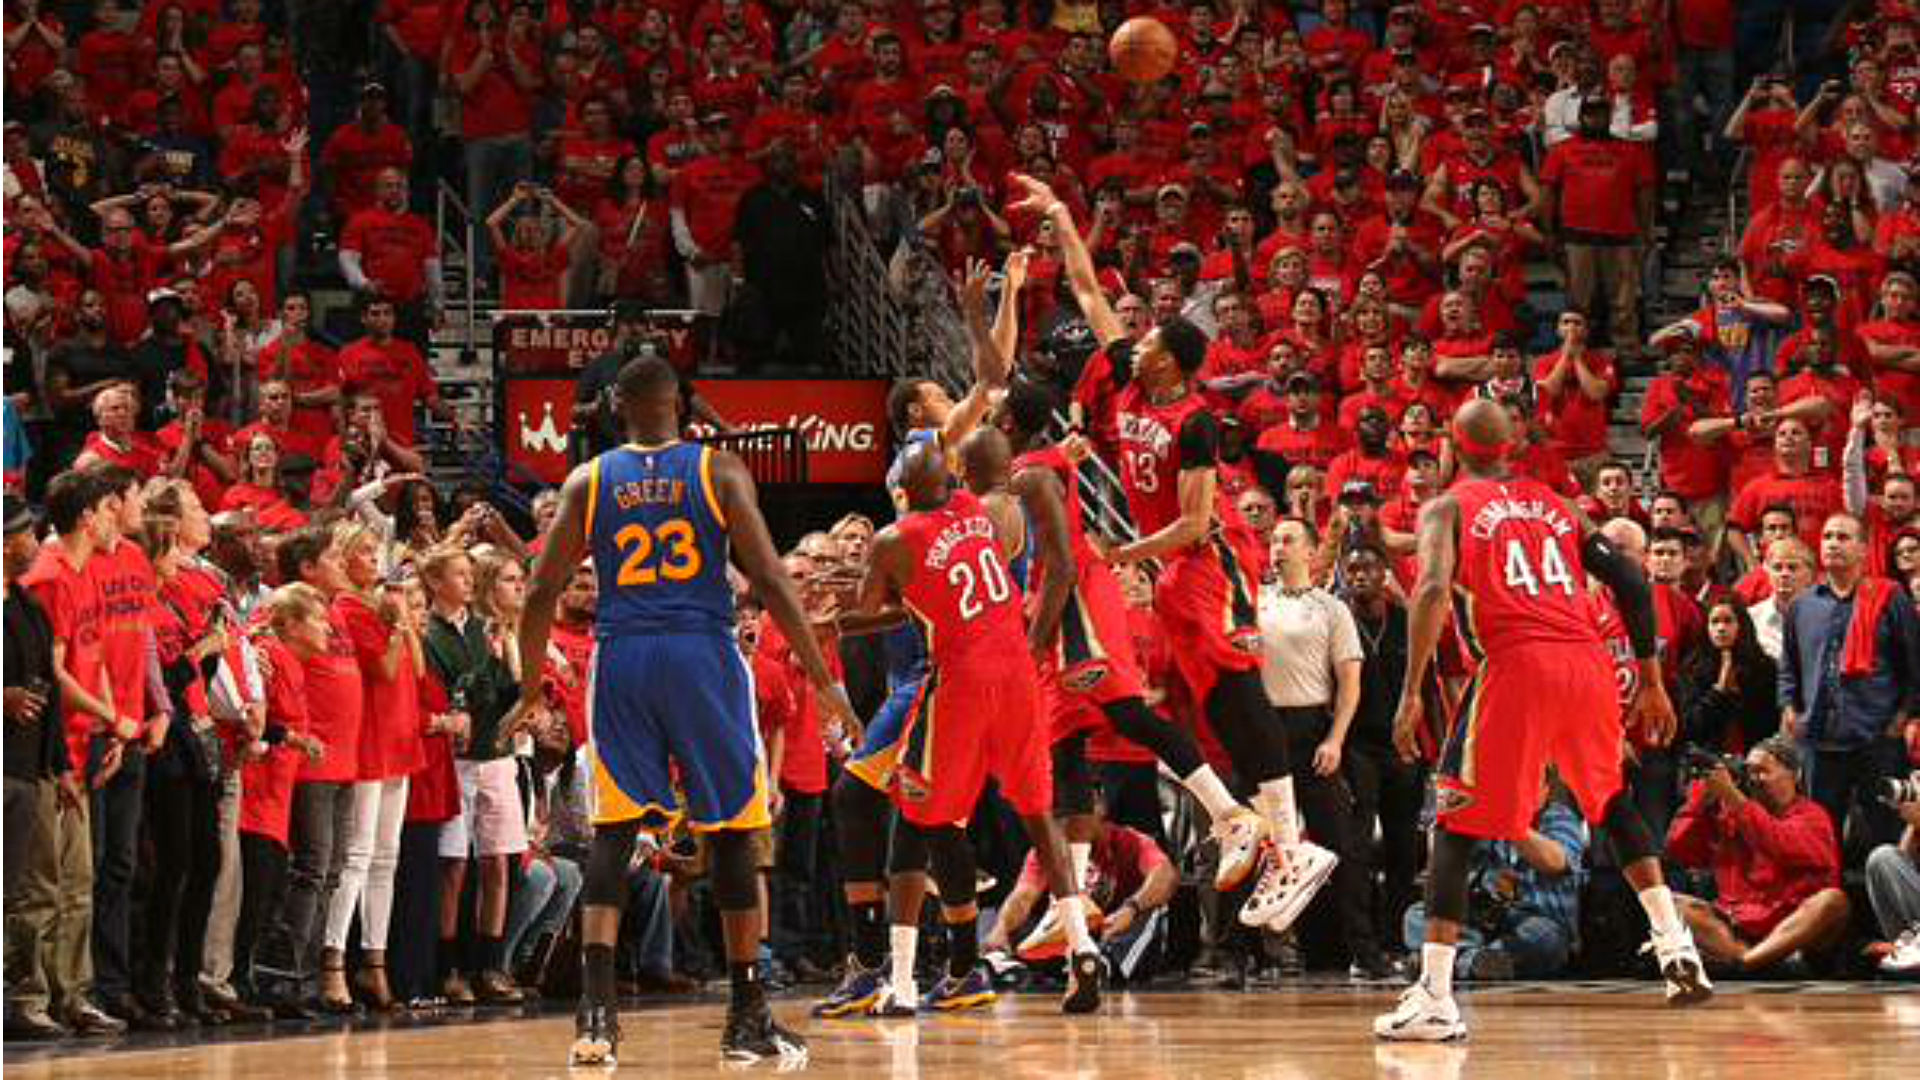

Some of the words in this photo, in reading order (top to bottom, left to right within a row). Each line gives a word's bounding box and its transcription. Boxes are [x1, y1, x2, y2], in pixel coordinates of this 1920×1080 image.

[511, 328, 689, 349] EMERGY
[613, 478, 685, 509] GREEN
[615, 520, 702, 585] 23
[1504, 535, 1575, 596] 44
[948, 548, 1010, 620] 20
